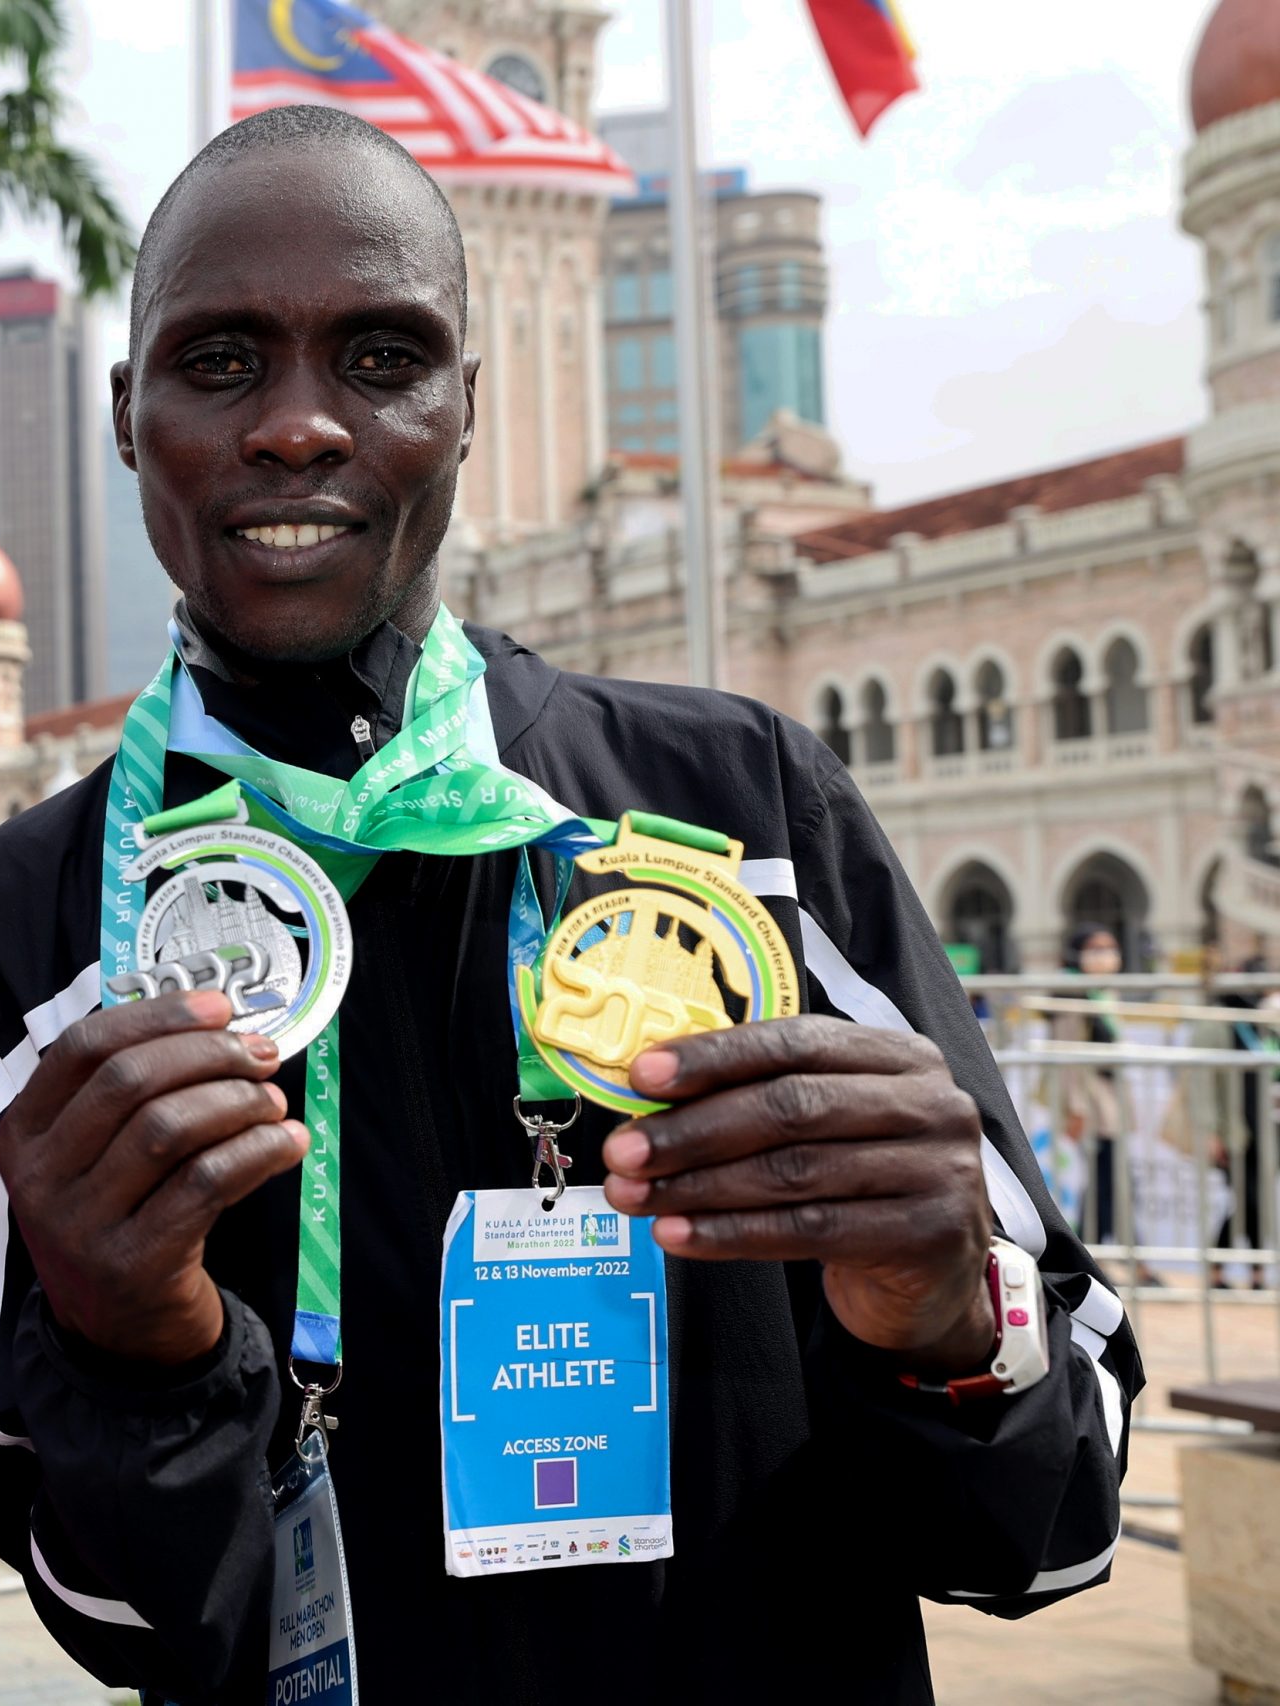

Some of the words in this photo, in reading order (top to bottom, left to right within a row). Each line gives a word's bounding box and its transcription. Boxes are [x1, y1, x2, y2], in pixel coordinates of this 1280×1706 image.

[342, 749, 416, 832] Chartered
[137, 848, 169, 873] Kuala
[169, 831, 216, 851] Lumpur
[220, 830, 276, 849] Standard
[278, 845, 327, 892] Chartered
[323, 891, 346, 951] Marathon
[598, 852, 640, 866] Kuala
[645, 852, 701, 875] Lumpur
[703, 871, 759, 919] Standard
[756, 920, 790, 991] Chartered
[316, 1038, 329, 1100] LUM
[312, 1119, 328, 1223] KUALA
[484, 1230, 525, 1240] Standard
[528, 1229, 575, 1239] Chartered
[485, 1219, 522, 1229] KUALA
[527, 1217, 575, 1227] LUMPUR
[507, 1240, 550, 1249] Marathon
[553, 1238, 575, 1247] 2022
[474, 1267, 489, 1281] 12
[491, 1266, 502, 1280] &
[504, 1265, 519, 1280] 13
[521, 1263, 593, 1279] November
[594, 1261, 630, 1276] 2022
[516, 1322, 590, 1351] ELITE
[491, 1359, 616, 1391] ATHLETE
[502, 1436, 561, 1456] ACCESS
[563, 1434, 608, 1452] ZONE
[279, 1612, 296, 1636] FULL
[296, 1591, 336, 1625] MARATHON
[290, 1630, 306, 1651] MEN
[306, 1618, 326, 1643] OPEN
[275, 1654, 345, 1706] POTENTIAL
